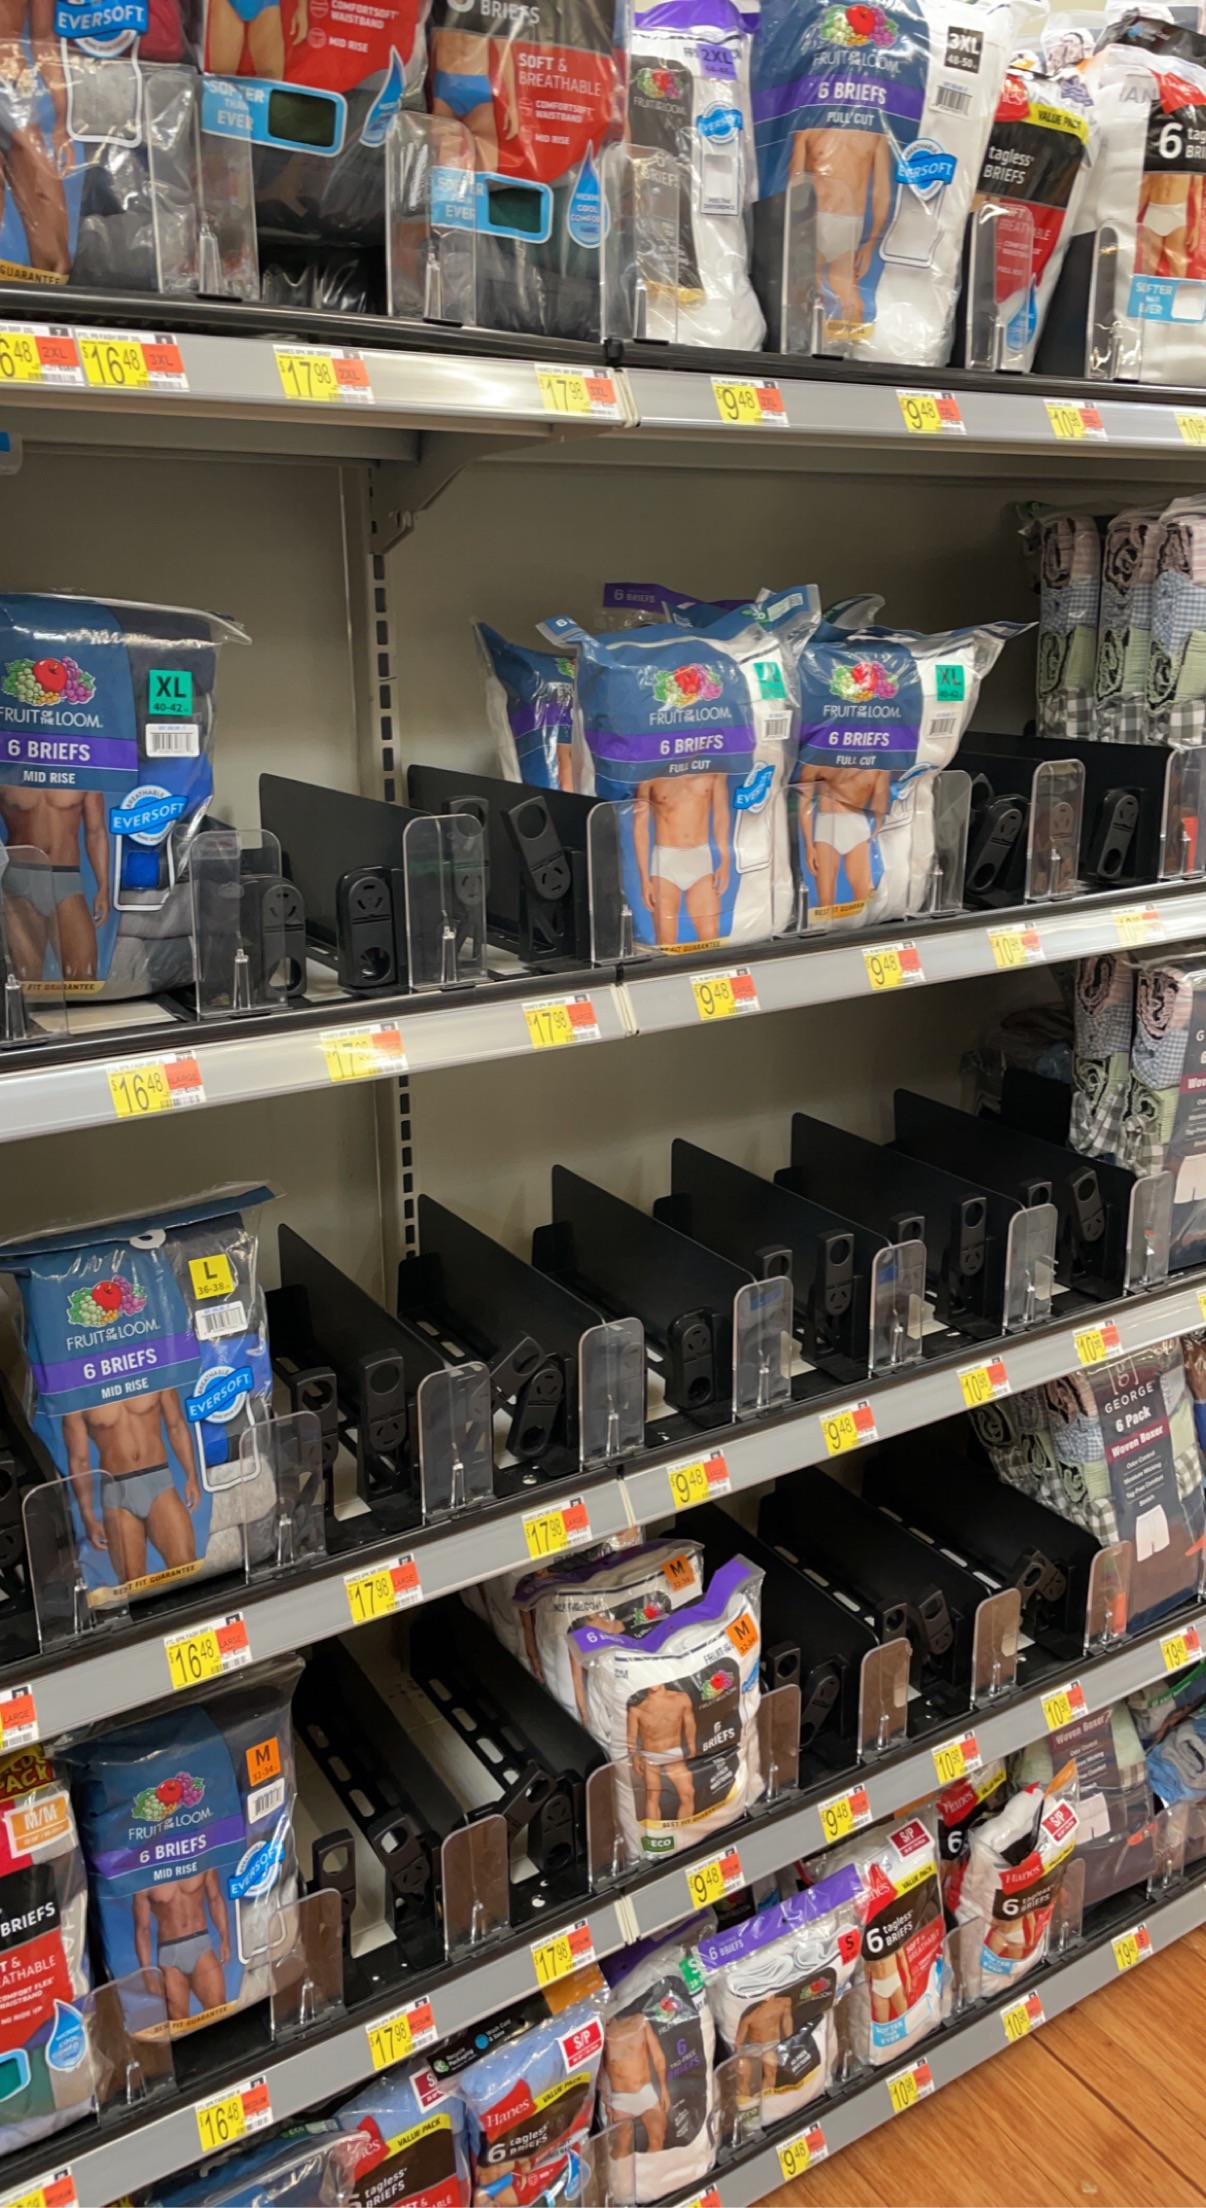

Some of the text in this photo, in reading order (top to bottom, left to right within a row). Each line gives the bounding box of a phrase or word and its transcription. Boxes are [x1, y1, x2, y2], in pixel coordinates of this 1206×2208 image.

[58, 7, 145, 28] EVERSOFT
[331, 11, 384, 29] WAISTBAND
[329, 36, 369, 52] MID RISE
[949, 33, 980, 54] 3XL
[518, 52, 567, 71] SOFT &
[701, 50, 733, 66] 2XL
[518, 72, 602, 97] BREATHABLE
[818, 82, 887, 105] 6 BRIEFS
[217, 112, 254, 131] EVER
[853, 112, 874, 126] CUT
[1038, 110, 1081, 130] VALUE PACK
[1159, 123, 1184, 159] 6
[989, 146, 1033, 166] tagless
[983, 165, 1026, 184] BRIEFS
[445, 204, 476, 219] EVER
[613, 589, 624, 600] 6
[156, 676, 186, 698] XL
[940, 671, 961, 686] XL
[0, 707, 40, 725] FRUIT
[153, 703, 182, 712] 40-42
[649, 709, 683, 725] FRUIT
[823, 705, 857, 717] FRUIT
[660, 734, 724, 755] 6 BRIEFS
[829, 732, 890, 746] 6 BRIEFS
[7, 739, 91, 762] 6 BRIEFS
[668, 759, 710, 773] FULL CUT
[836, 756, 876, 765] FULL CUT
[23, 770, 76, 785] MID RISE
[113, 802, 185, 829] EVERSOFT
[205, 1261, 218, 1281] L
[67, 1332, 105, 1350] FRUIT
[83, 1349, 157, 1380] 6 BRIEFS
[101, 1378, 150, 1399] MID RISE
[189, 1373, 249, 1416] EVERSOFT
[1105, 1382, 1154, 1413] GEORGE
[1116, 1406, 1151, 1432] 6 Pack
[1111, 1426, 1163, 1458] Woven Boxer
[135, 1578, 147, 1589] FIT
[150, 1566, 196, 1585] GUARANTEE
[672, 1563, 684, 1576] M
[393, 1574, 415, 1589] LARGE
[586, 1632, 598, 1643] 6
[735, 1622, 749, 1639] M
[219, 1634, 243, 1649] LARGE
[2, 1709, 30, 1724] LARGE
[703, 1728, 735, 1752] BRIEFS
[1055, 1726, 1082, 1744] Woven
[256, 1747, 270, 1763] M
[24, 1803, 57, 1831] M/M
[1048, 1811, 1066, 1828] S/P
[128, 1820, 165, 1841] FRUIT
[900, 1827, 914, 1843] S/P
[139, 1835, 207, 1864] 6 BRIEFS
[651, 1839, 671, 1847] ECO
[948, 1832, 963, 1852] 6
[153, 1862, 198, 1881] MID RISE
[1005, 1867, 1040, 1884] Hanes
[1002, 1898, 1019, 1915] 6
[1, 1902, 55, 1937] BRIEFS
[866, 1910, 912, 1953] 6 tagless
[886, 1924, 913, 1946] BRIEFS
[709, 1939, 744, 1960] 6 BRIEFS
[846, 1936, 854, 1947] S
[1, 2006, 43, 2025] NO RIDE UP
[573, 2030, 591, 2049] S/P
[676, 2038, 687, 2055] 6
[543, 2085, 563, 2102] VALUE
[487, 2098, 530, 2127] Hanes
[397, 2118, 441, 2146] VALUE PACK
[488, 2144, 506, 2163] 6
[365, 2168, 407, 2198] tagless
[367, 2181, 405, 2208] BRIEFS
